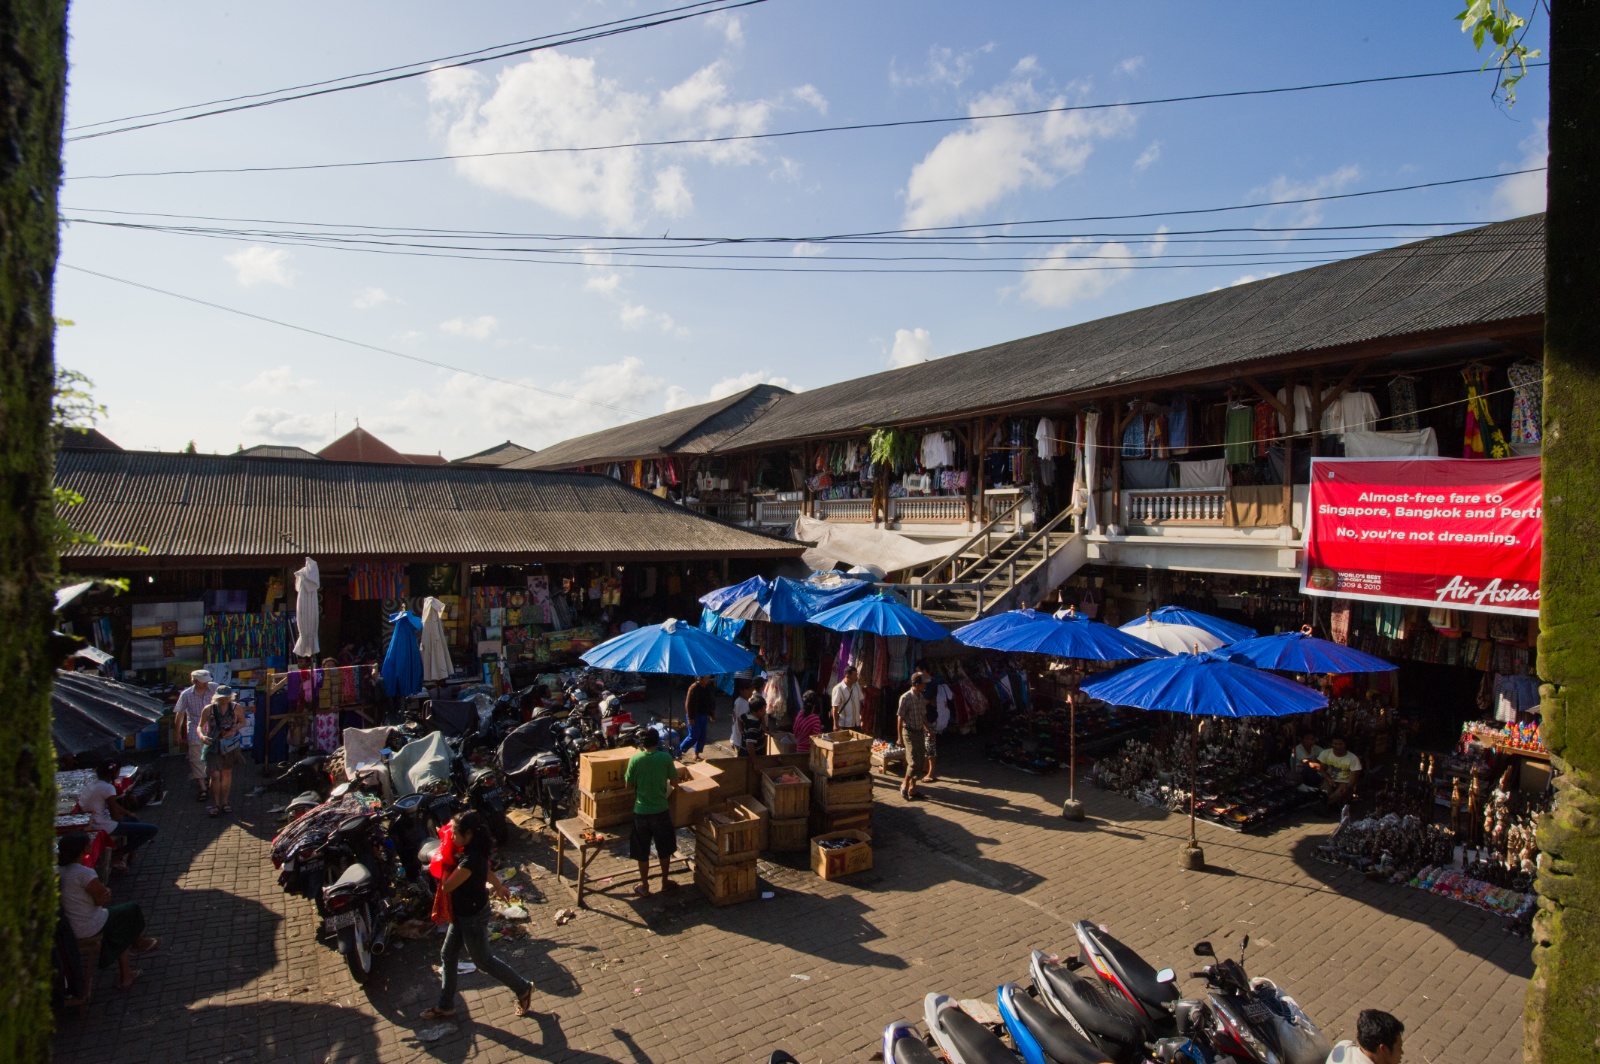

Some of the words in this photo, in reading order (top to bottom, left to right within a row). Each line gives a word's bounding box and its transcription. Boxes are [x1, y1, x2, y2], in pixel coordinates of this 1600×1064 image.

[1358, 492, 1445, 504] Almost-free
[1449, 492, 1481, 504] fare
[1485, 493, 1503, 504] to
[1318, 504, 1391, 518] Singapore,
[1395, 506, 1461, 520] Bangkok
[1464, 507, 1496, 519] and
[1336, 527, 1359, 540] No,
[1361, 529, 1405, 541] you're
[1408, 531, 1435, 541] not
[1437, 531, 1521, 545] dreaming.
